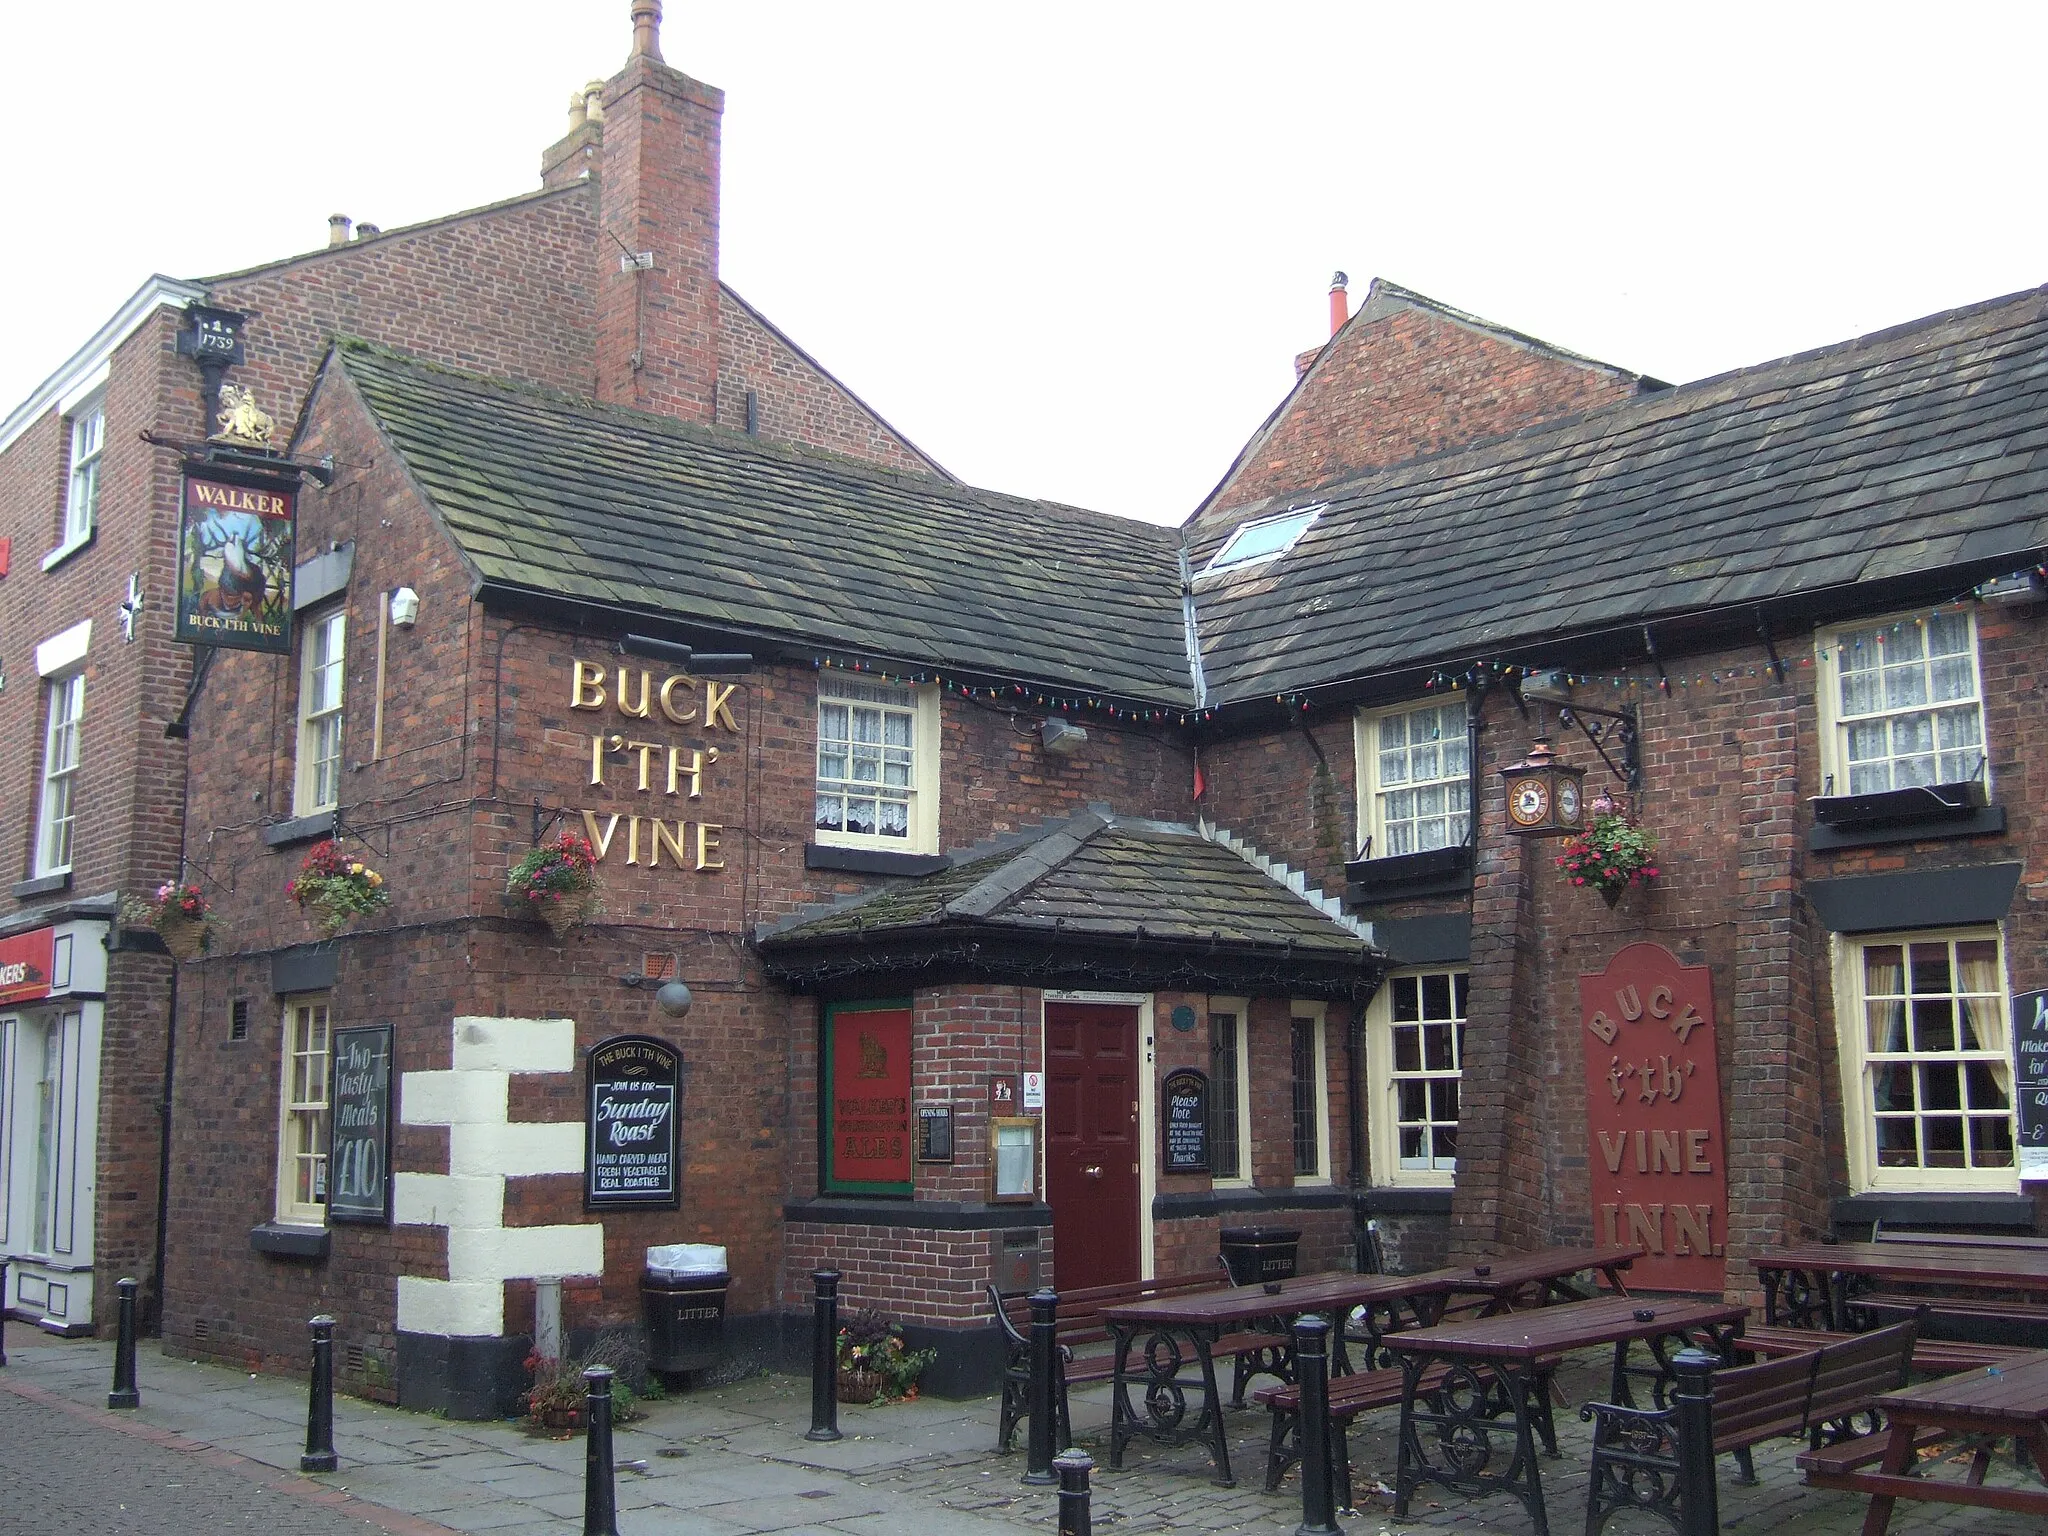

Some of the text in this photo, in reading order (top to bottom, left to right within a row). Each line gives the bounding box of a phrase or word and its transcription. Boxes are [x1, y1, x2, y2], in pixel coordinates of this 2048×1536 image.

[195, 484, 285, 515] WALKER
[189, 614, 221, 629] BUCK
[252, 622, 282, 636] VINE
[570, 658, 742, 732] BUCK
[590, 734, 720, 798] I'TH'
[581, 809, 726, 872] VINE
[1587, 984, 1705, 1046] BUCK
[347, 1040, 372, 1070] Two
[599, 1051, 615, 1067] THE
[615, 1046, 636, 1060] BUCK
[656, 1053, 673, 1070] VINE
[340, 1071, 375, 1105] Tasty
[610, 1081, 656, 1092] JOIN US FOR
[340, 1101, 379, 1127] Meals
[597, 1096, 671, 1126] Sunday
[1171, 1095, 1198, 1107] Please
[1172, 1108, 1191, 1119] Note
[609, 1117, 658, 1147] Roast
[596, 1152, 668, 1165] HAND CARVED MEAT
[841, 1136, 903, 1159] ALES
[1173, 1152, 1196, 1162] Thanks
[1597, 1129, 1712, 1173] VINE
[338, 1138, 378, 1198] £10
[597, 1165, 668, 1177] FRESH VEGETABLES
[600, 1176, 660, 1188] REAL ROASTIES
[1600, 1203, 1724, 1257] INN.
[1262, 1258, 1293, 1271] LITTER
[677, 1307, 720, 1320] LITTER
